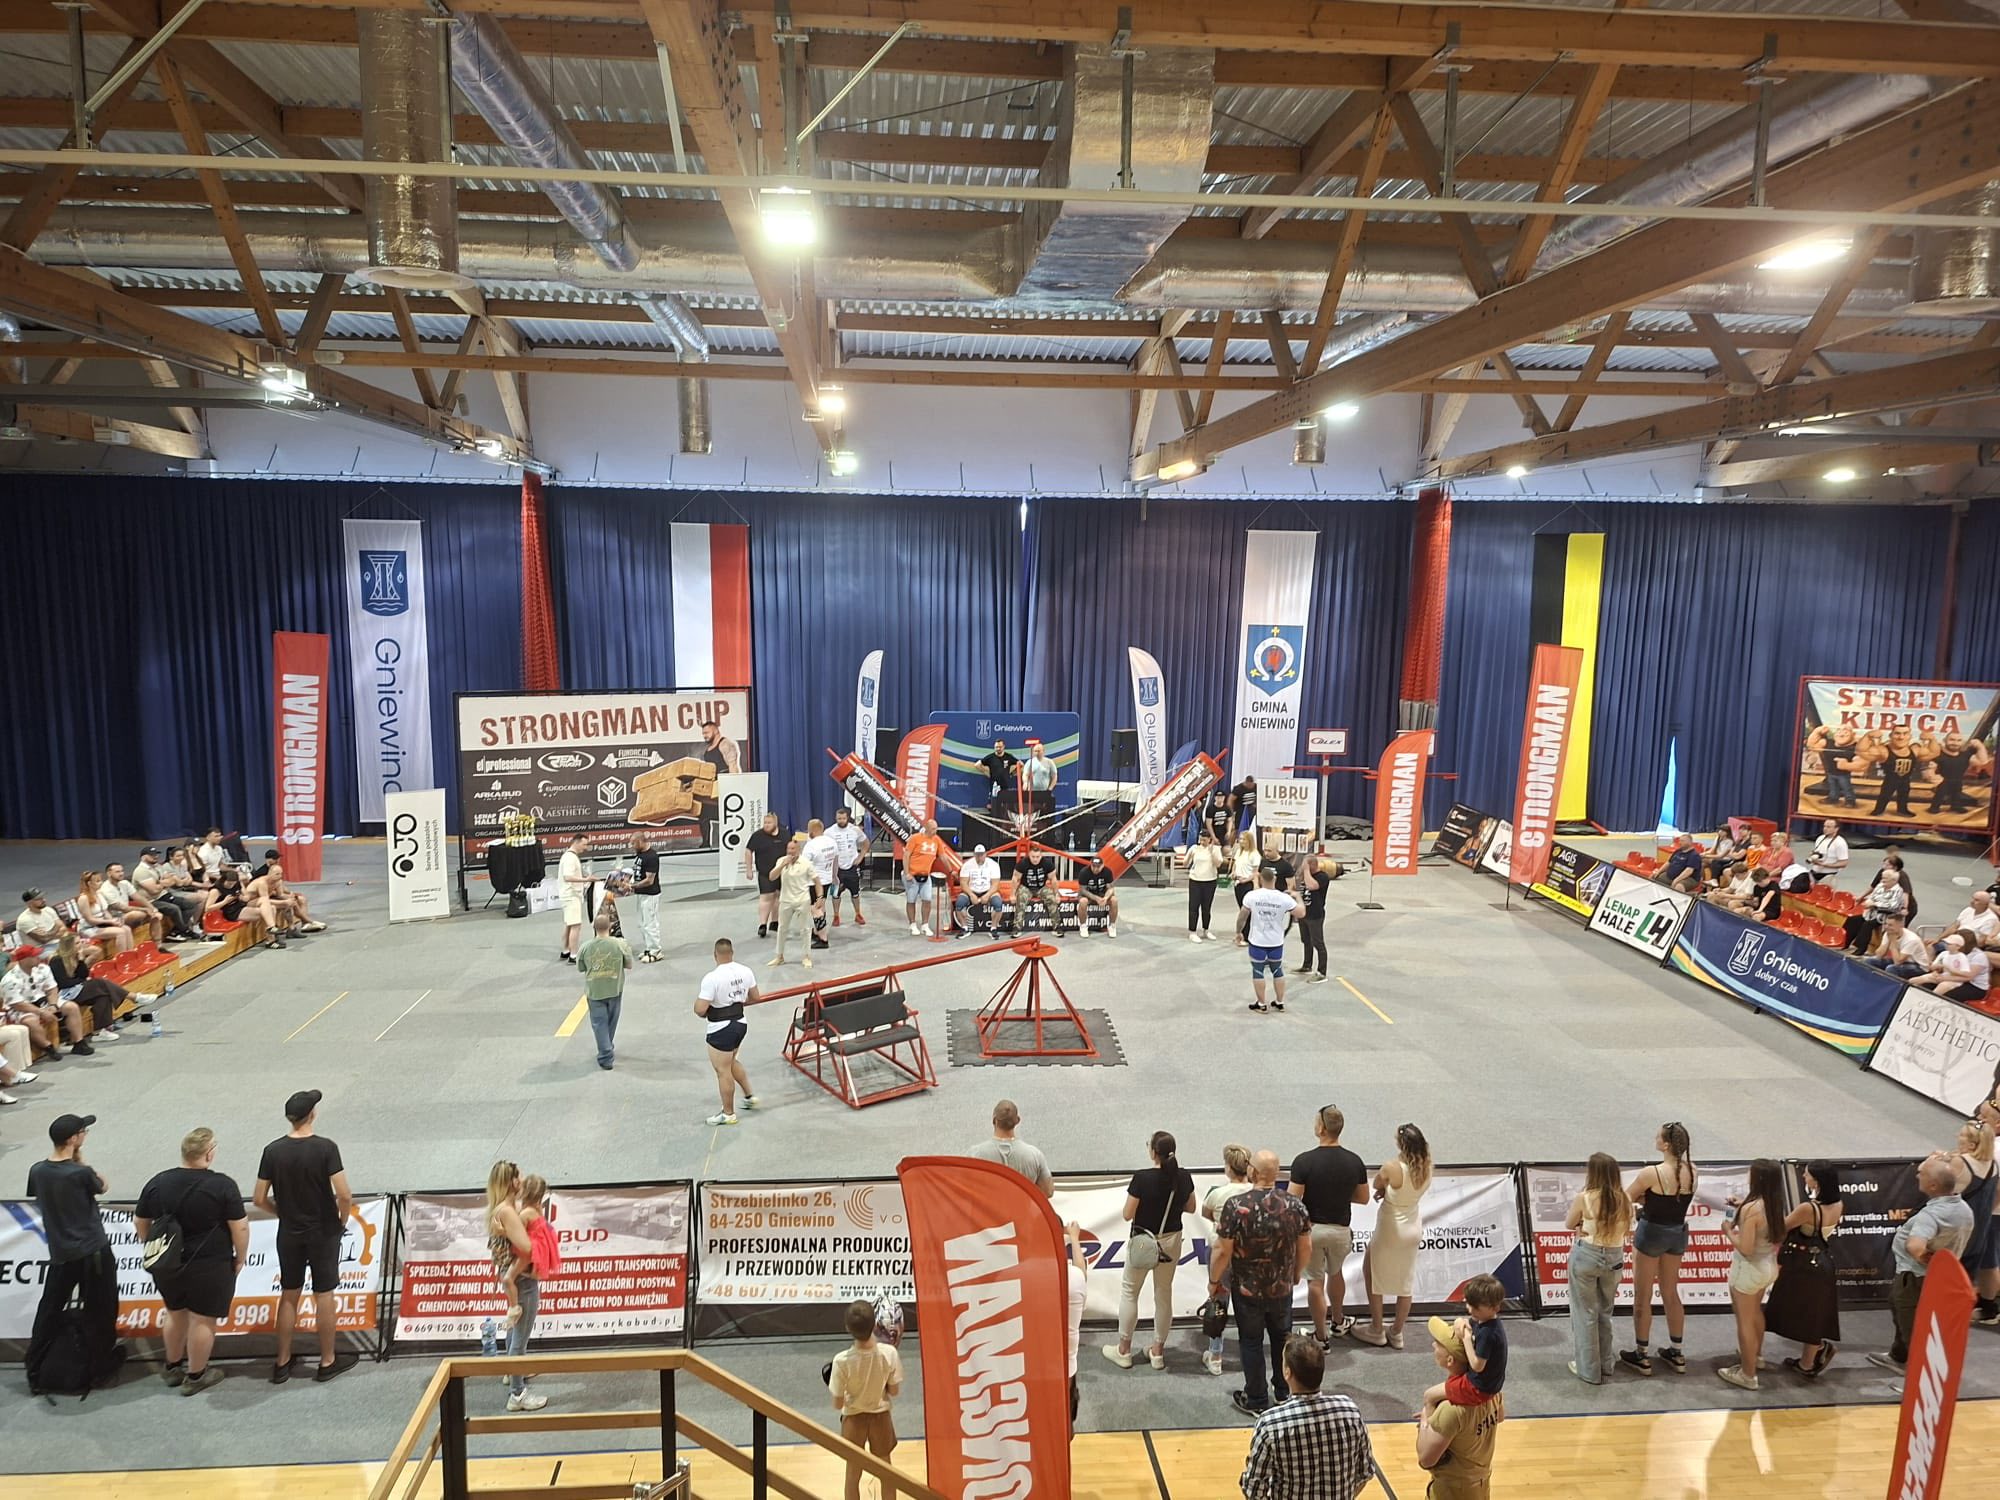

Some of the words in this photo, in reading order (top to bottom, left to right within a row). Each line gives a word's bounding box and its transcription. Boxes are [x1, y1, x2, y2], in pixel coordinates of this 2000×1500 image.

[1251, 701, 1288, 714] GMINA
[1837, 688, 1967, 711] STREFA
[480, 704, 669, 746] STRONGMAN
[677, 700, 730, 730] CUP
[993, 723, 1033, 732] Gniewino
[1241, 717, 1295, 730] GNIEWINO
[1841, 711, 1961, 735] KIBICA
[282, 673, 320, 846] STRONGMAN
[474, 790, 522, 799] ARKABUD
[546, 784, 590, 792] EUROCEMENT
[1264, 784, 1309, 801] LIBRU
[546, 807, 592, 817] AESTHETIC
[1385, 753, 1419, 869] STRONGMAN
[588, 822, 625, 830] STRONGMAN
[593, 842, 627, 852] Fundacja
[1558, 849, 1578, 864] AGIS
[1604, 897, 1641, 919] LENAP
[1598, 910, 1635, 936] HALE
[1755, 968, 1780, 987] dobry
[1763, 950, 1830, 991] Gniewino
[1898, 1008, 2000, 1063] AESTHETIC
[710, 1192, 809, 1209] Strzebielinko
[813, 1191, 837, 1209] 26,
[709, 1212, 763, 1229] 84-250
[768, 1211, 836, 1228] Gniewino
[1844, 1212, 1883, 1224] wszystko
[1426, 1223, 1490, 1237] INŻYNIERYJNE
[1837, 1226, 1854, 1237] jest
[708, 1237, 828, 1254] PROFESJONALNA
[1418, 1237, 1493, 1250] DROINSTAL
[1695, 1234, 1721, 1246] USŁUGI
[1703, 1248, 1734, 1262] ROZBIÓ
[409, 1262, 451, 1278] SPRZEDAŻ
[452, 1260, 493, 1277] PIASKÓW,
[583, 1260, 613, 1273] USŁUGI
[614, 1257, 681, 1271] TRANSPORTOWE,
[725, 1260, 731, 1277] I
[735, 1254, 828, 1277] PRZEWODÓW
[832, 1259, 914, 1276] ELEKTRYCZ
[1678, 1268, 1698, 1279] ORAZ
[1698, 1268, 1721, 1279] BETON
[412, 1282, 446, 1296] ROBOTY
[584, 1277, 589, 1291] I
[589, 1275, 635, 1291] ROZBIÓRKI
[636, 1275, 676, 1289] PODSYPKA
[704, 1284, 734, 1297] +48
[738, 1283, 769, 1298] 607
[416, 1299, 509, 1313] CEMENTOWO-PIASKOWA
[556, 1296, 579, 1309] ORAZ
[580, 1295, 605, 1309] BETON
[606, 1295, 622, 1308] POD
[623, 1291, 669, 1309] KRAWĘŻNIK
[234, 1304, 270, 1326] 998
[358, 1315, 366, 1325] 5
[414, 1323, 433, 1333] 669
[436, 1322, 455, 1332] 120
[456, 1322, 475, 1332] 405
[563, 1315, 677, 1330] www.arkabud.pl
